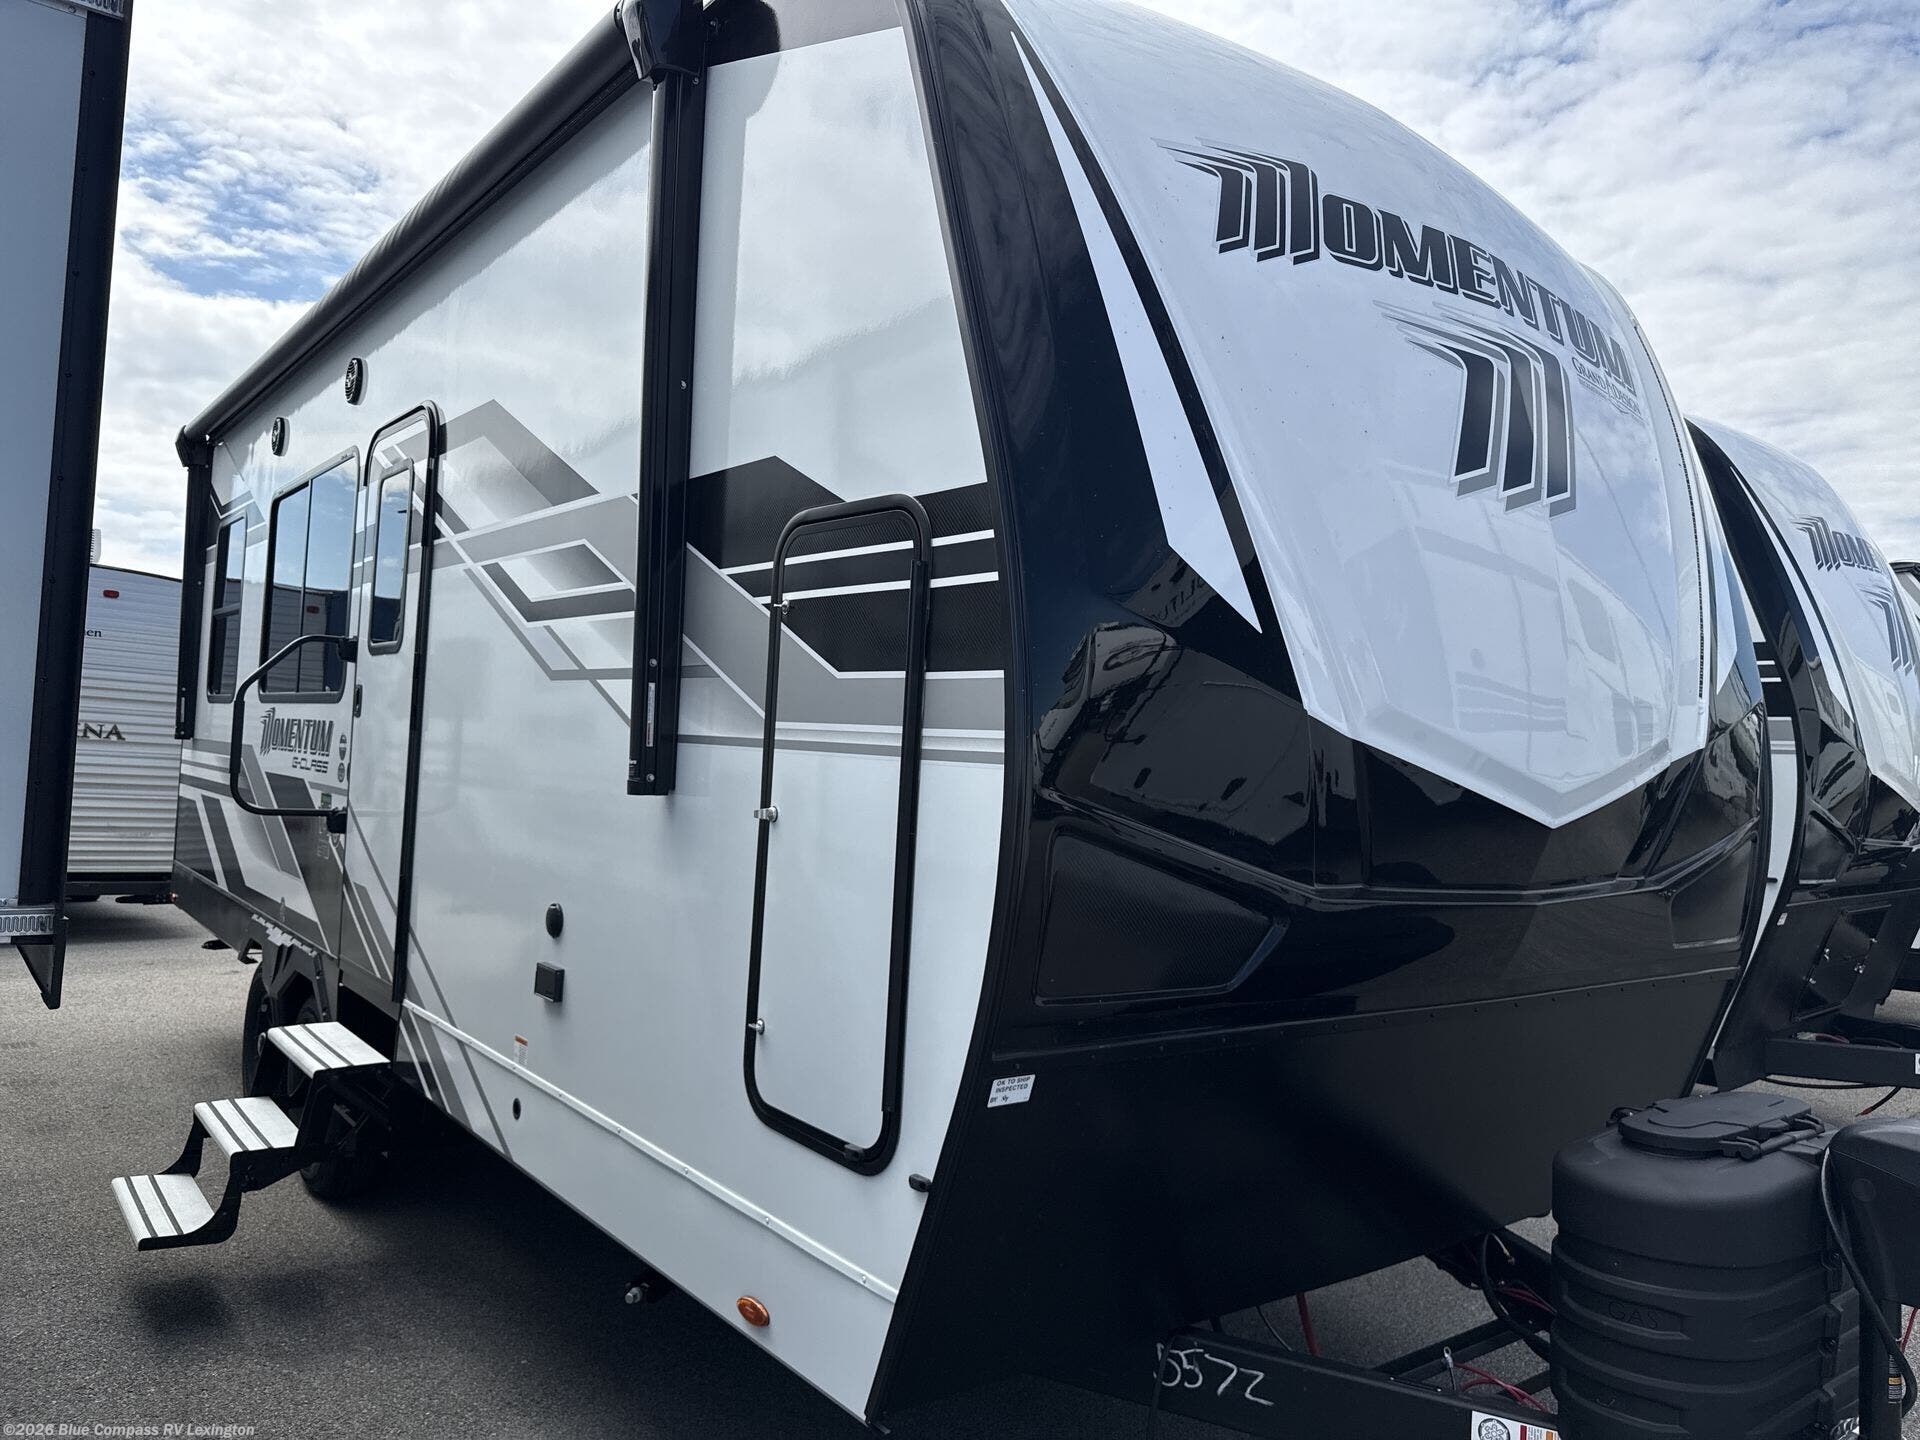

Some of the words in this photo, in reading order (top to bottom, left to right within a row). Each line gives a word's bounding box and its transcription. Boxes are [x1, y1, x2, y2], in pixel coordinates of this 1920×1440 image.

[1156, 137, 1636, 398] MOMENTUM
[260, 707, 334, 757] MOMENTUM
[995, 1083, 1029, 1093] INSPECTED
